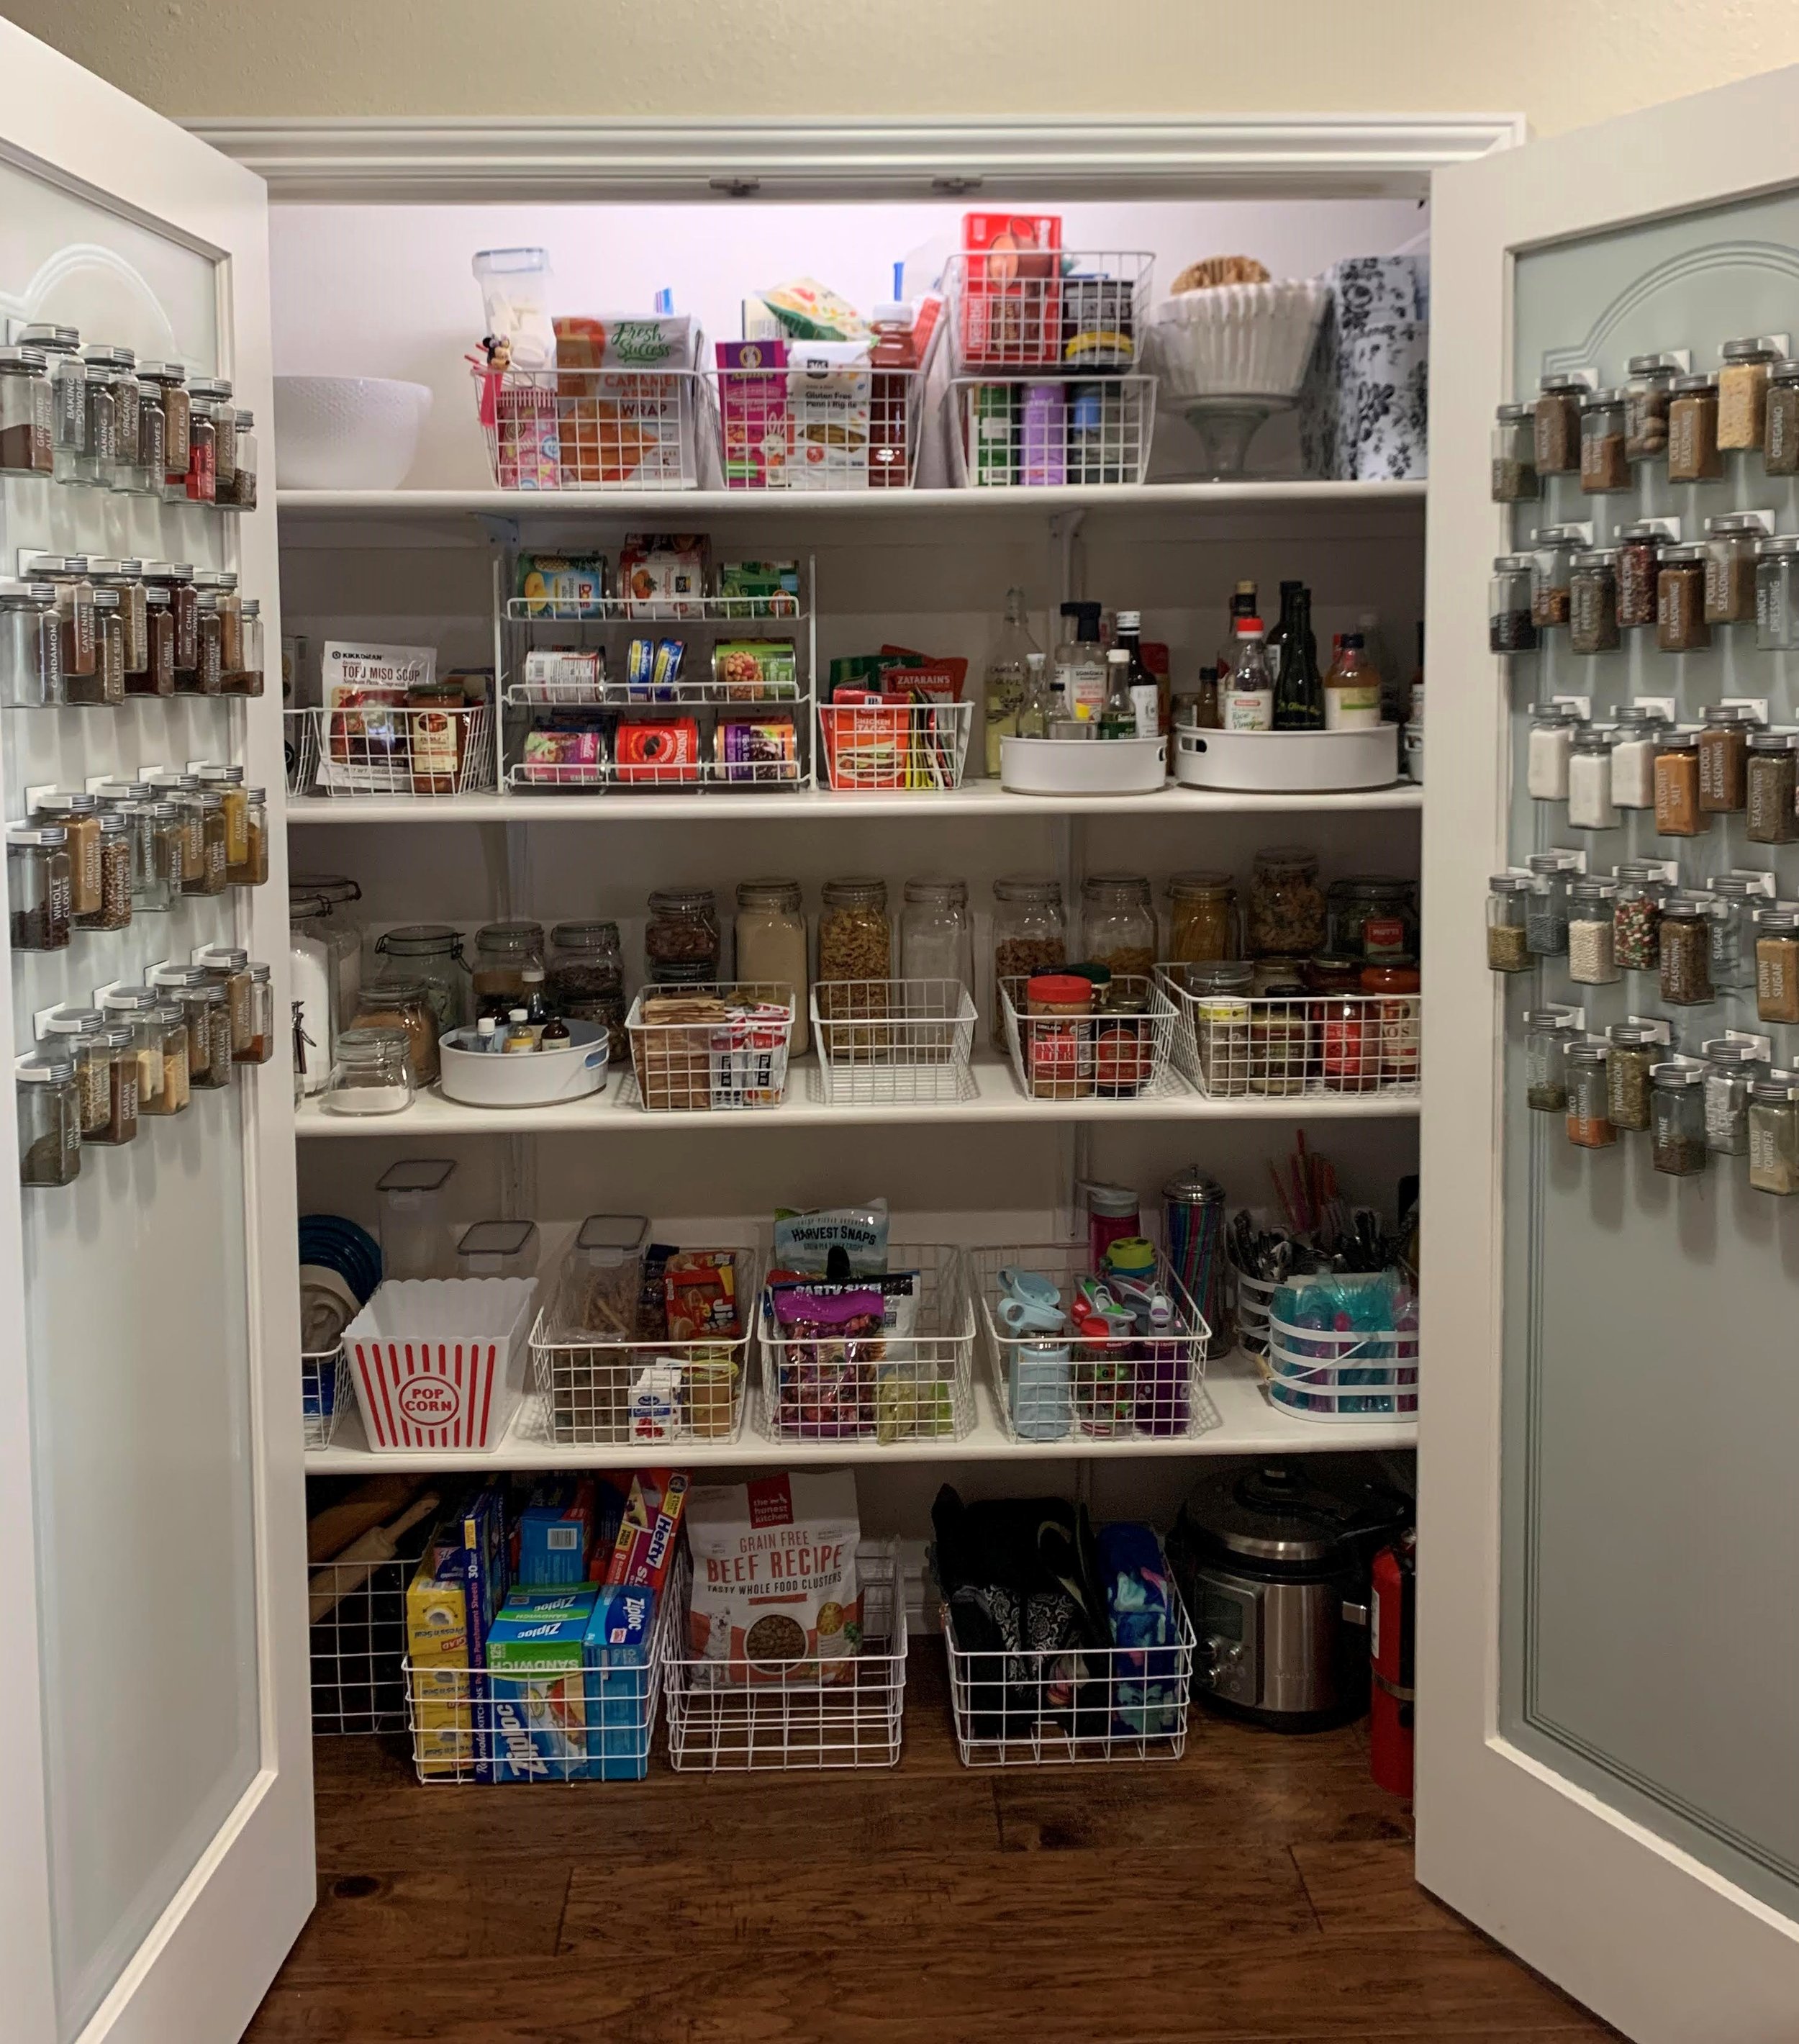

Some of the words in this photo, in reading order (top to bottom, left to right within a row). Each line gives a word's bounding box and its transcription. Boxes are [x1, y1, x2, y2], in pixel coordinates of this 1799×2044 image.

[611, 322, 666, 345] Fresh
[617, 339, 671, 359] Success
[66, 376, 75, 420] BAKING
[122, 389, 130, 437] ORGANIC
[622, 404, 668, 417] WRAP
[805, 391, 833, 400] Gluten
[834, 392, 852, 400] Free
[805, 400, 830, 409] Penn
[832, 401, 858, 410] Rigte
[36, 397, 45, 447] GROUND
[1772, 406, 1783, 458] OREGANO
[1669, 582, 1680, 640] SEASONING
[1757, 588, 1767, 625] RANCH
[1769, 580, 1781, 633] DRESSING
[80, 604, 89, 654] CAYENNE
[50, 623, 58, 689] CARDAMOM
[343, 652, 383, 661] KIKKOMAN
[369, 666, 394, 680] MISO
[396, 668, 420, 682] SOUP
[897, 674, 950, 684] ZATARAIN'S
[1700, 746, 1712, 793] SEAFOOD
[1713, 741, 1725, 799] SEASONING
[1657, 768, 1669, 820] SEASONED
[1671, 784, 1682, 806] SALT
[1752, 769, 1763, 828] SEASONING
[144, 814, 153, 882] CORNSTARCH
[52, 878, 62, 921] WHOLE
[1713, 926, 1724, 961] SUGAR
[1670, 937, 1681, 993] SEASONING
[1759, 959, 1771, 999] BROWN
[1772, 962, 1784, 998] SUGAR
[122, 1083, 130, 1121] GARAM
[130, 1077, 138, 1120] MASALA
[1613, 1062, 1625, 1112] TARRAGON
[1567, 1095, 1578, 1118] TACO
[1577, 1083, 1589, 1136] SEASONING
[1658, 1117, 1669, 1149] THYME
[1762, 1129, 1775, 1175] POWDER
[792, 1226, 839, 1243] HARVEST
[404, 1400, 453, 1412] CORN
[411, 1388, 445, 1401] POP
[753, 1504, 789, 1515] honest
[755, 1512, 789, 1524] kitchen
[645, 1516, 671, 1566] Hefty
[739, 1534, 777, 1554] GRAIN
[780, 1529, 810, 1547] FREE
[468, 1565, 479, 1579] 30
[705, 1554, 760, 1584] BEEF
[769, 1544, 846, 1579] RECIPE
[707, 1583, 737, 1595] TASTY
[738, 1582, 771, 1596] WHOLE
[774, 1579, 799, 1593] FOOD
[801, 1571, 843, 1591] CLUSTERS
[533, 1595, 576, 1612] Ziploc
[626, 1597, 646, 1632] Ziploc
[414, 1629, 434, 1639] Seal
[434, 1626, 464, 1637] Press'n
[517, 1622, 561, 1639] Ziploc
[490, 1659, 579, 1670] SANDWICH
[496, 1703, 550, 1777] Ziploc
